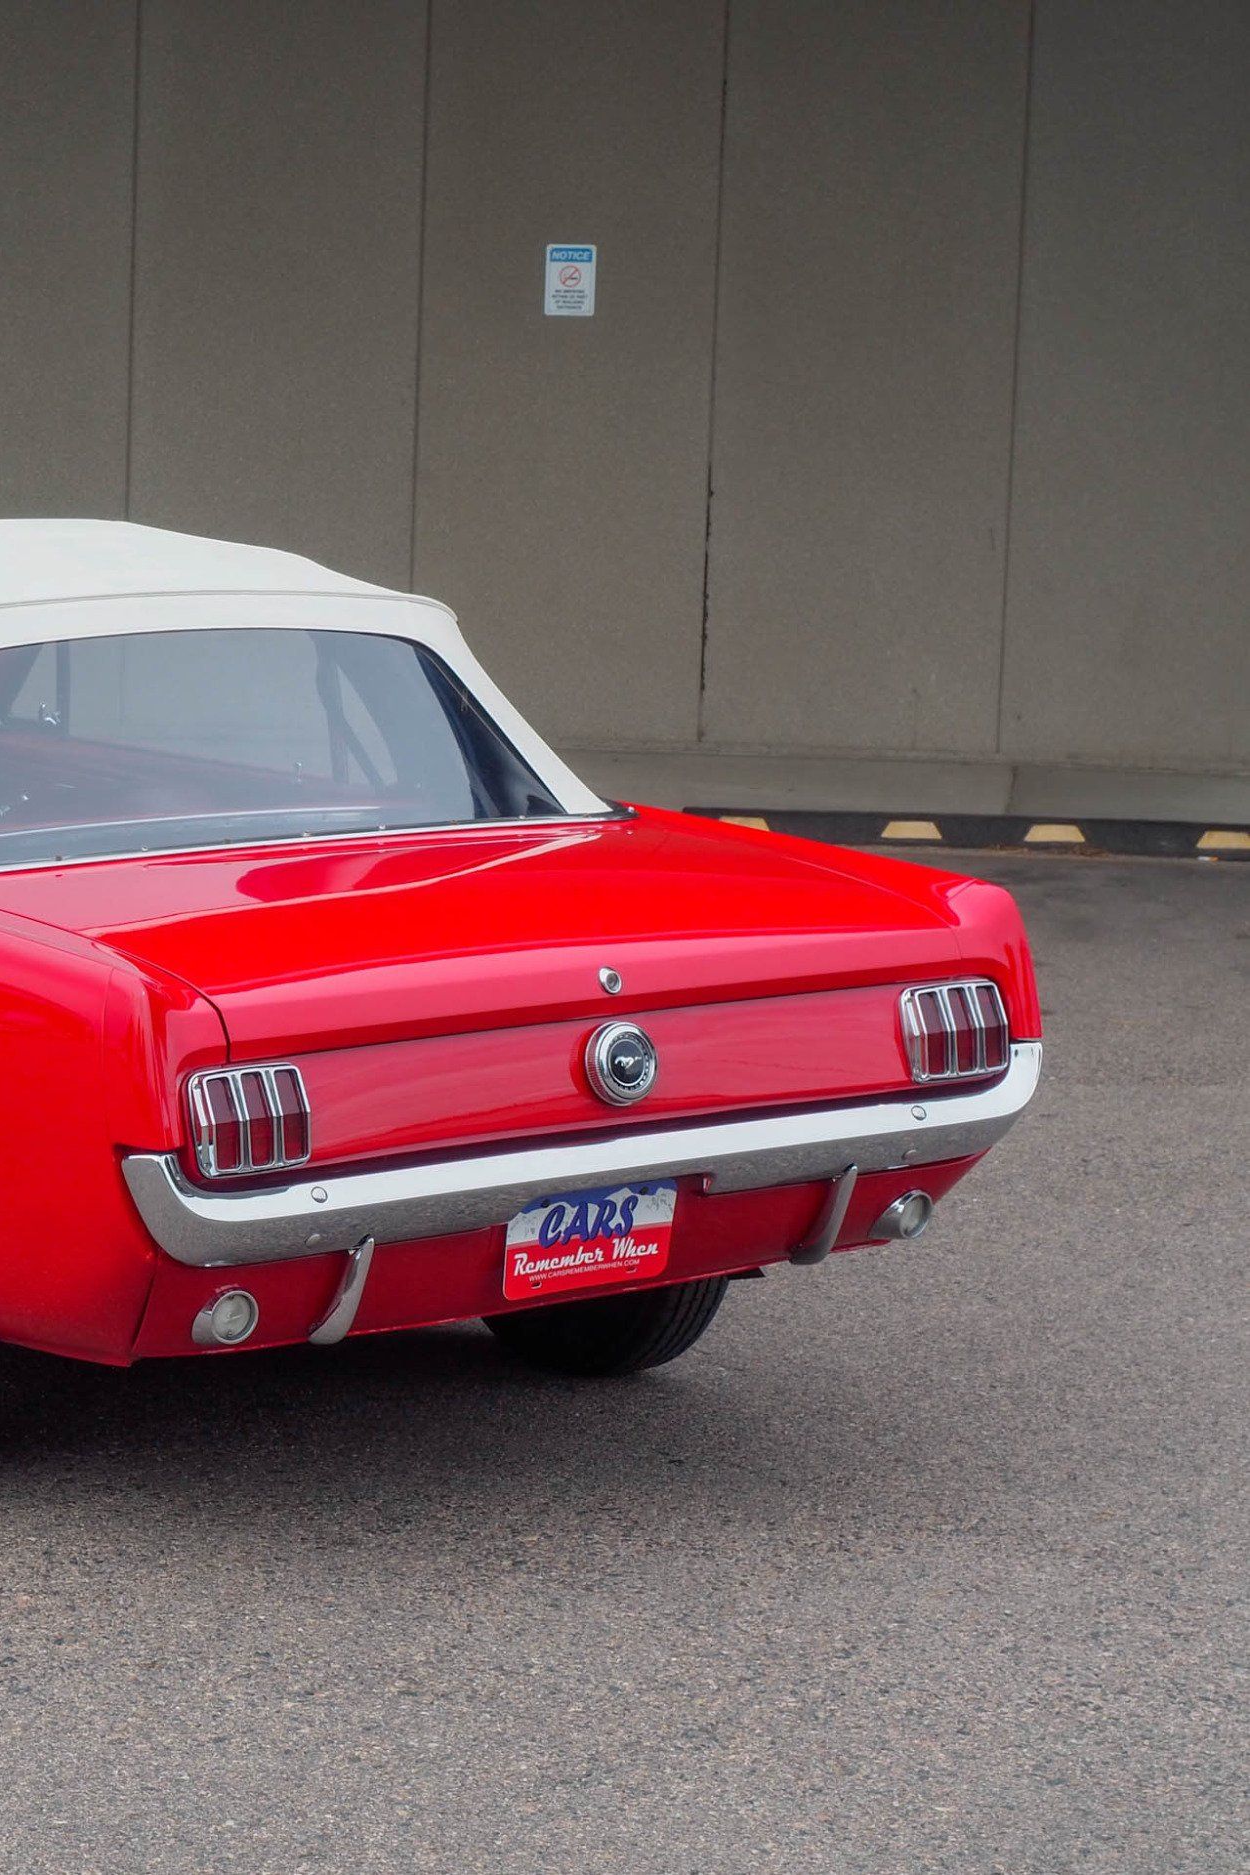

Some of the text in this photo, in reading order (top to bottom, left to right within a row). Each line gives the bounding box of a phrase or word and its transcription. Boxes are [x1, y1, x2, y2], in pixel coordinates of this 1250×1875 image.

[551, 251, 591, 261] NOTICE
[538, 1194, 639, 1248] CARS
[513, 1237, 659, 1276] Remember When
[528, 1259, 640, 1282] WWW.CARSREMEMBERWHEN.COM
